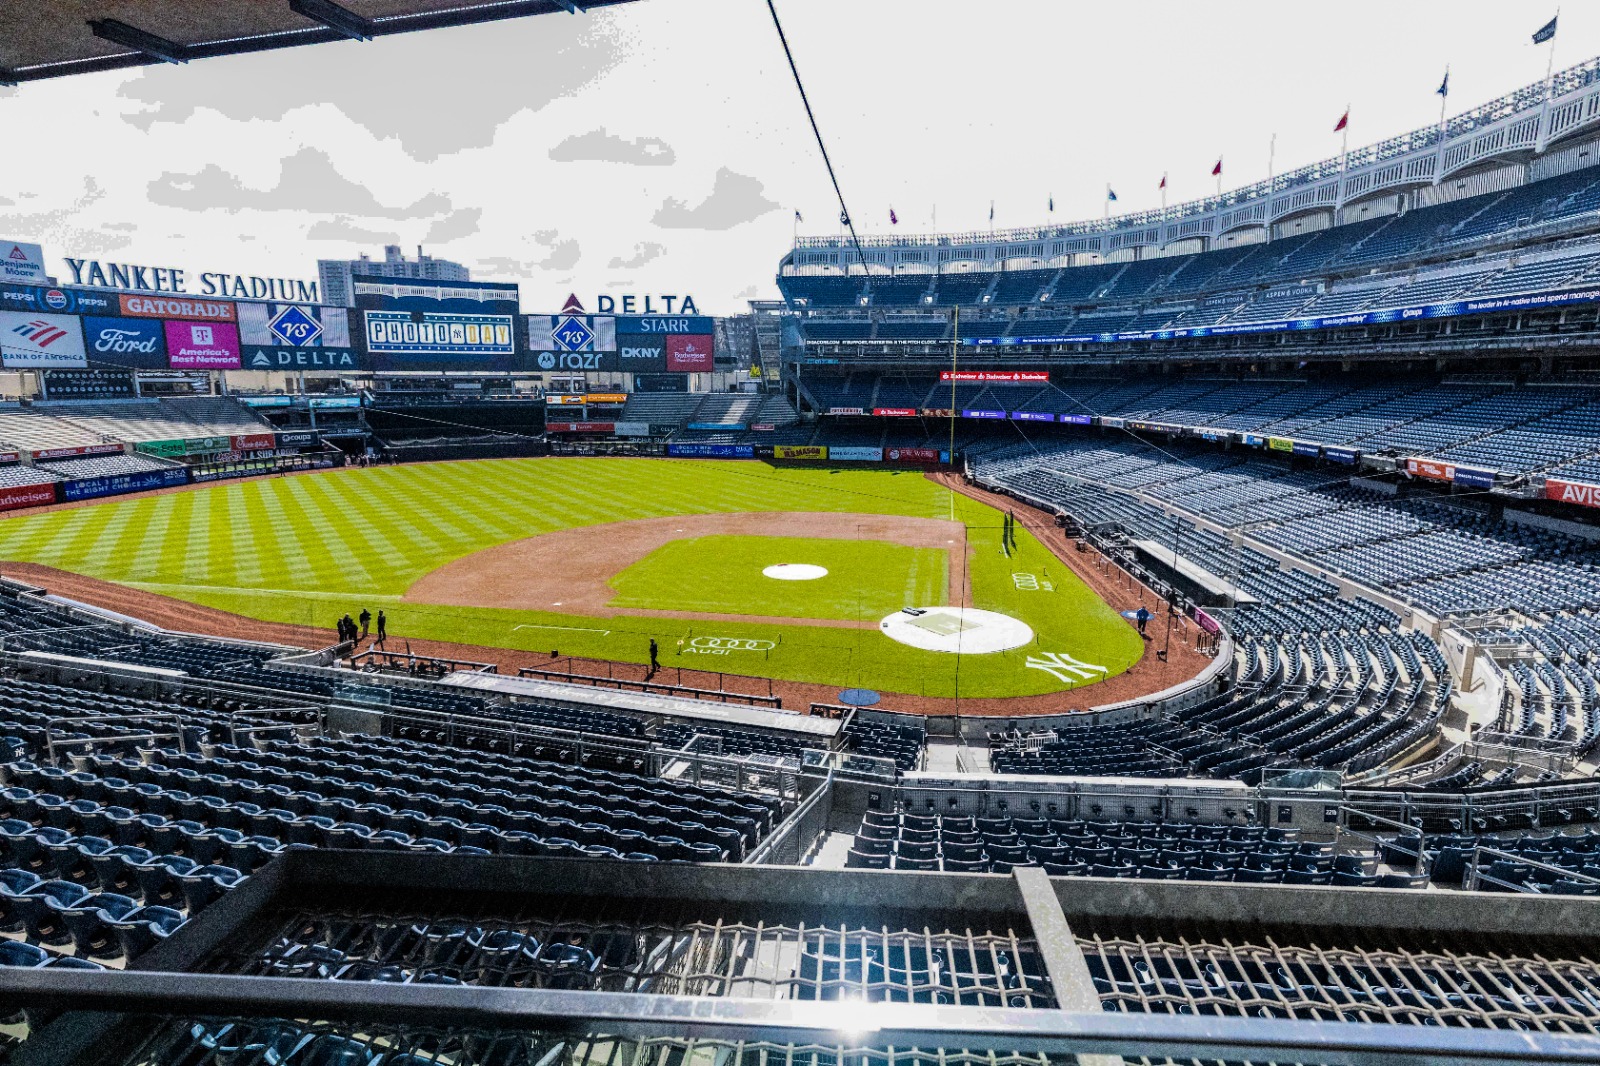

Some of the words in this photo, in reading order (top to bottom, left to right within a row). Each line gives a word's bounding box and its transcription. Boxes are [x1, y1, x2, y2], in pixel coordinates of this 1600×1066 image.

[0, 259, 40, 270] Benjamin
[5, 267, 35, 277] Moore
[63, 257, 187, 294] YANKEE
[200, 272, 319, 303] STADIUM
[3, 291, 35, 302] PEPSI
[78, 297, 107, 307] PEPSI
[127, 298, 231, 318] GATORADE
[598, 295, 697, 314] DELTA
[641, 318, 690, 332] STARR
[374, 322, 448, 342] PHOTO
[469, 324, 507, 344] DAY
[95, 328, 156, 353] Ford
[3, 353, 29, 361] BANK
[179, 348, 230, 356] America's
[621, 347, 661, 358] DKNY
[171, 355, 195, 363] Best
[196, 356, 239, 364] Network
[277, 351, 353, 365] DELTA
[560, 353, 603, 369] razr
[290, 434, 312, 443] coupa
[66, 489, 81, 497] THE
[84, 485, 109, 494] RIGHT
[112, 481, 141, 490] CHOICE
[75, 481, 101, 489] LOCAL
[682, 647, 732, 656] Audi
